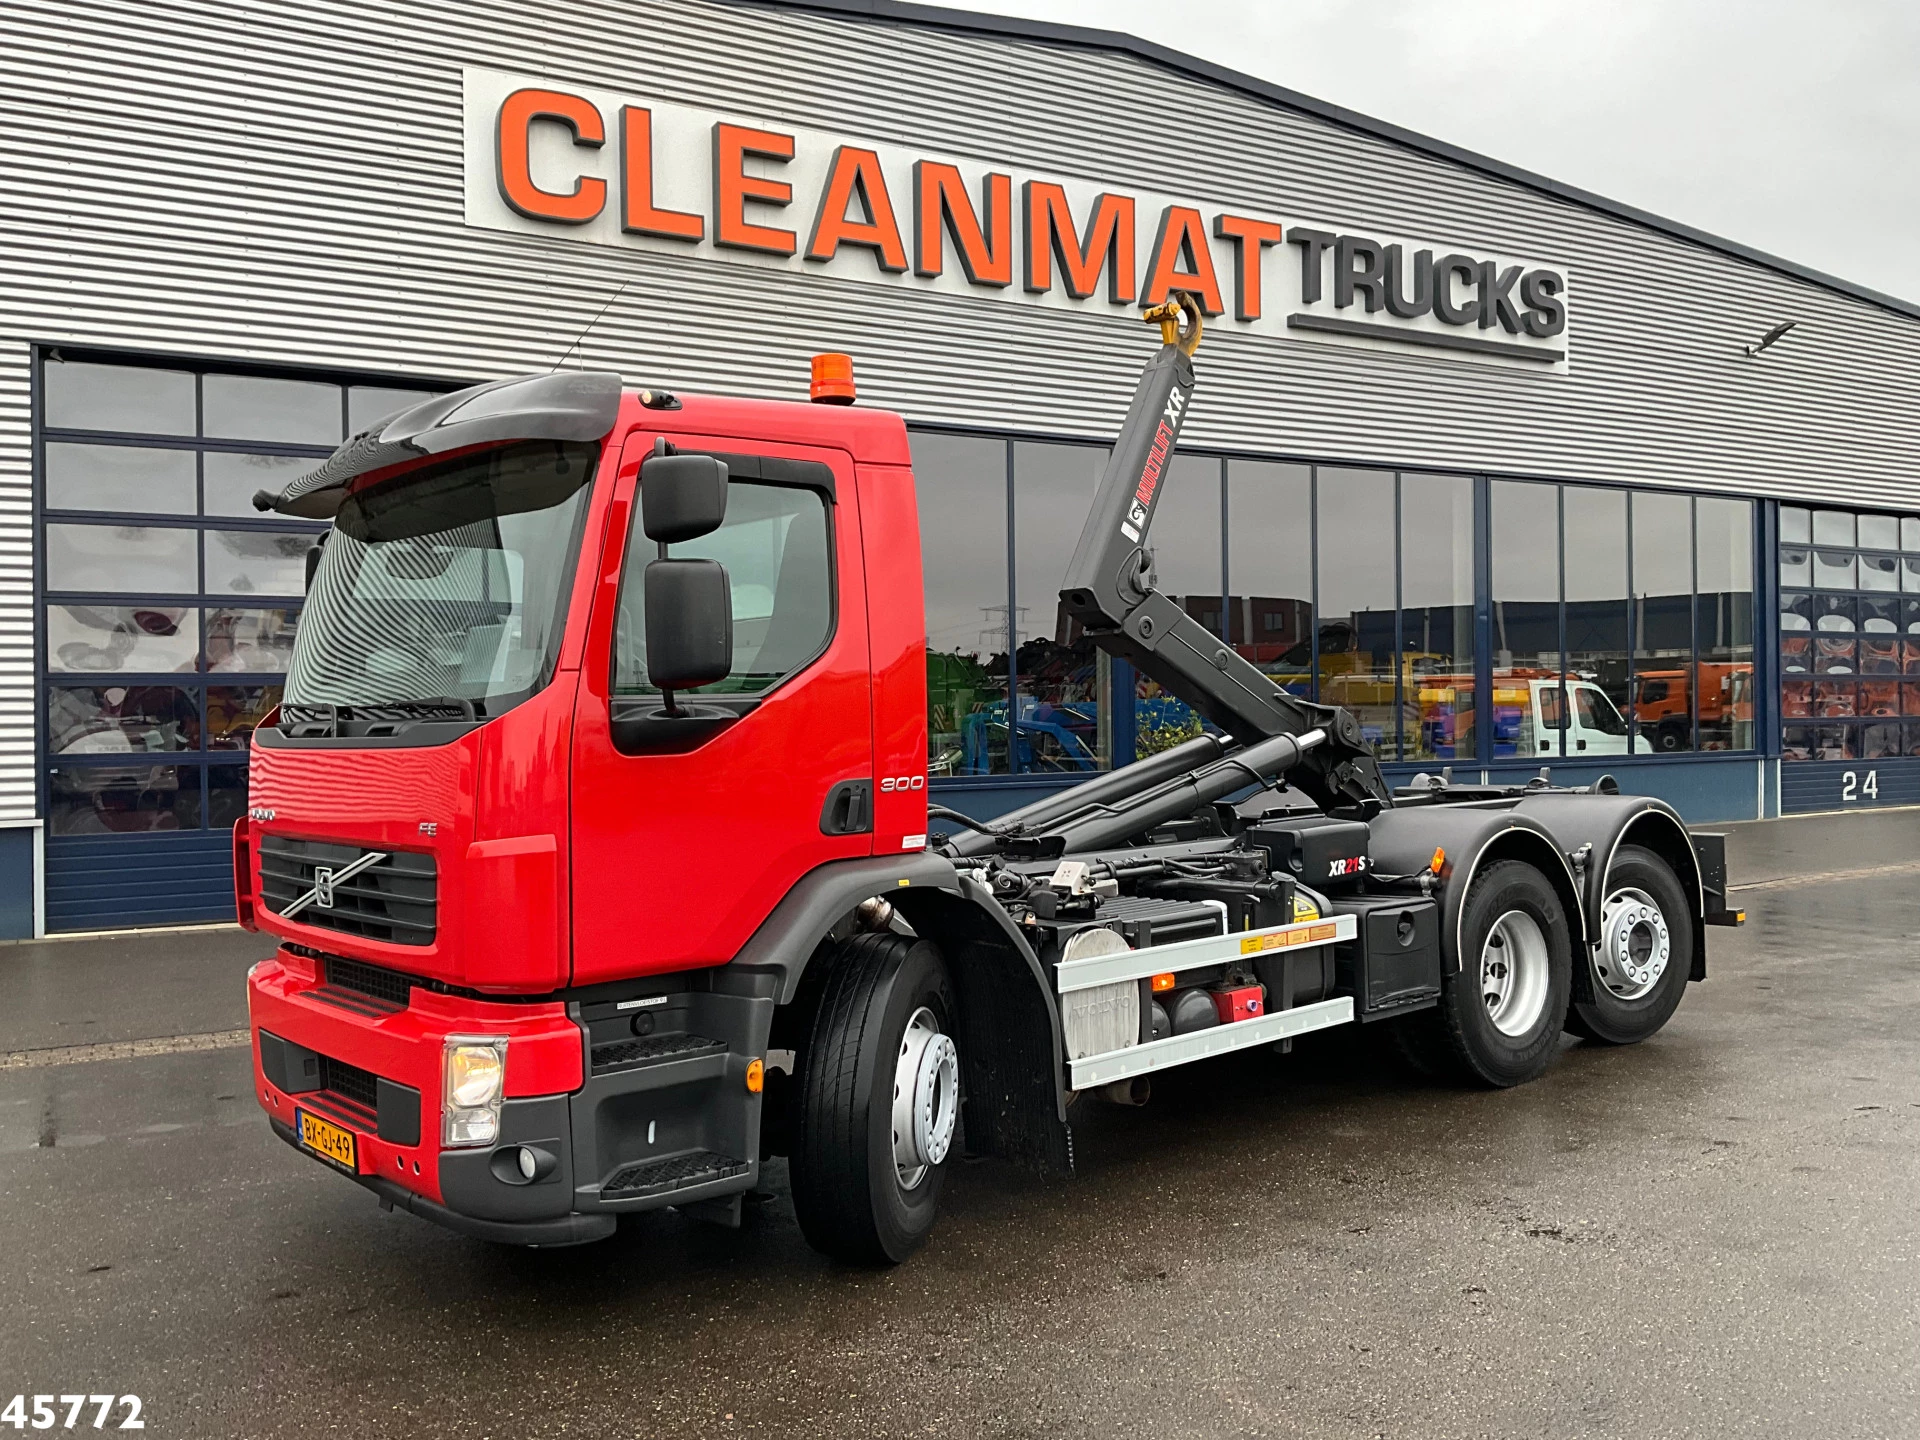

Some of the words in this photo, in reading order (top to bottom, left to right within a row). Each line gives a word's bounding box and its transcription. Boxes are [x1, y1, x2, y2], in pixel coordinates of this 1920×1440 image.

[495, 88, 1282, 322] CLEANMAT
[1287, 227, 1565, 337] TRUCKS
[1136, 420, 1173, 504] MULTILIFT
[1164, 386, 1184, 427] XR
[880, 776, 924, 792] 300
[1842, 770, 1878, 801] 24
[418, 822, 438, 837] FE
[1328, 855, 1366, 877] XR21S
[1073, 996, 1130, 1018] VOLVO
[305, 1118, 350, 1160] BX-GJ-49
